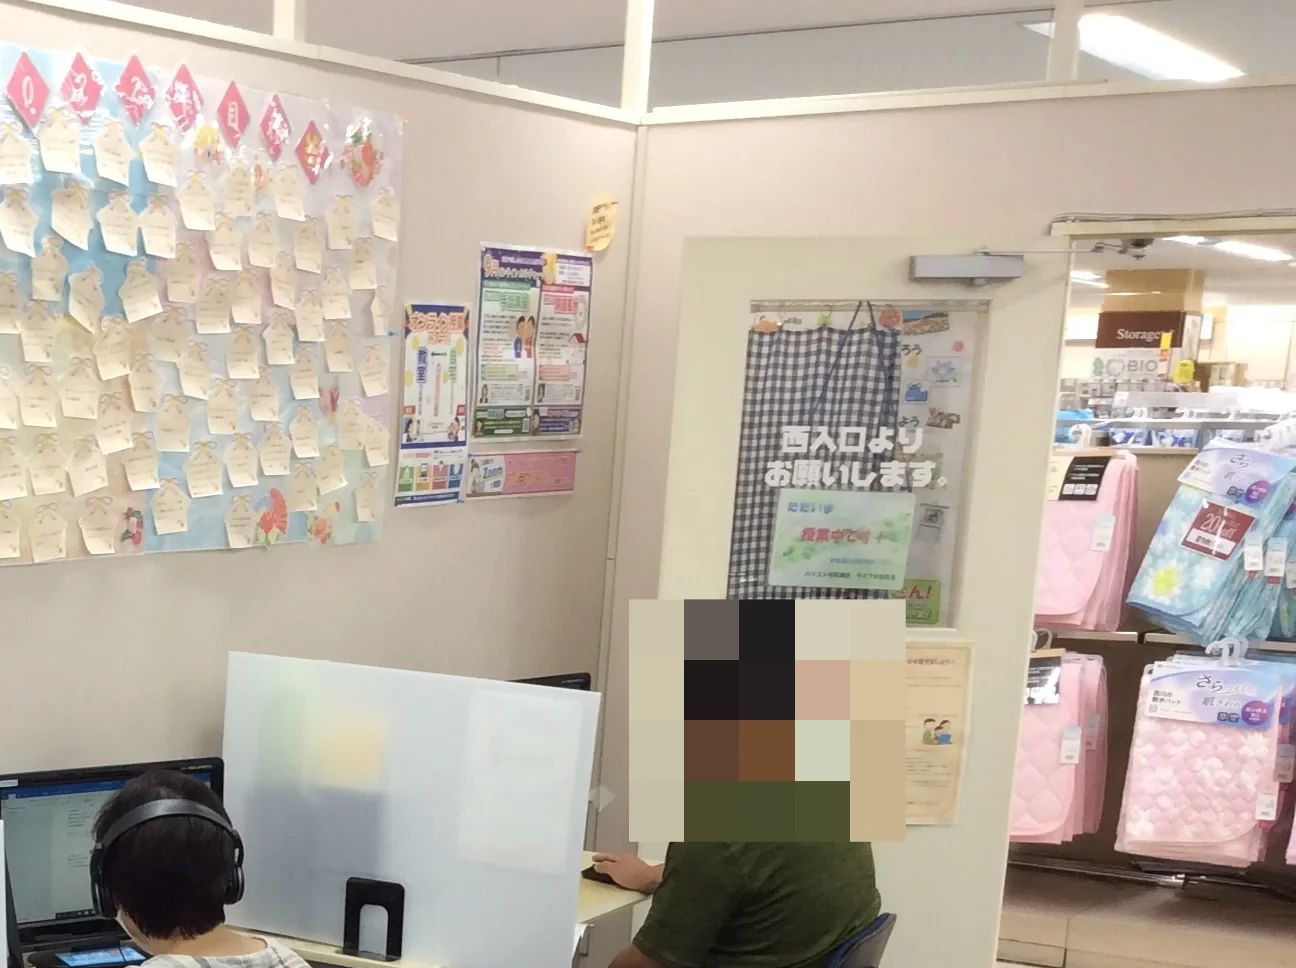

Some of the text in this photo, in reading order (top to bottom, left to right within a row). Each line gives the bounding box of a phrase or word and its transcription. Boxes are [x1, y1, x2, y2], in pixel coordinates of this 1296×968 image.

[782, 426, 923, 453] 西入口より
[764, 460, 949, 488] お願いします。
